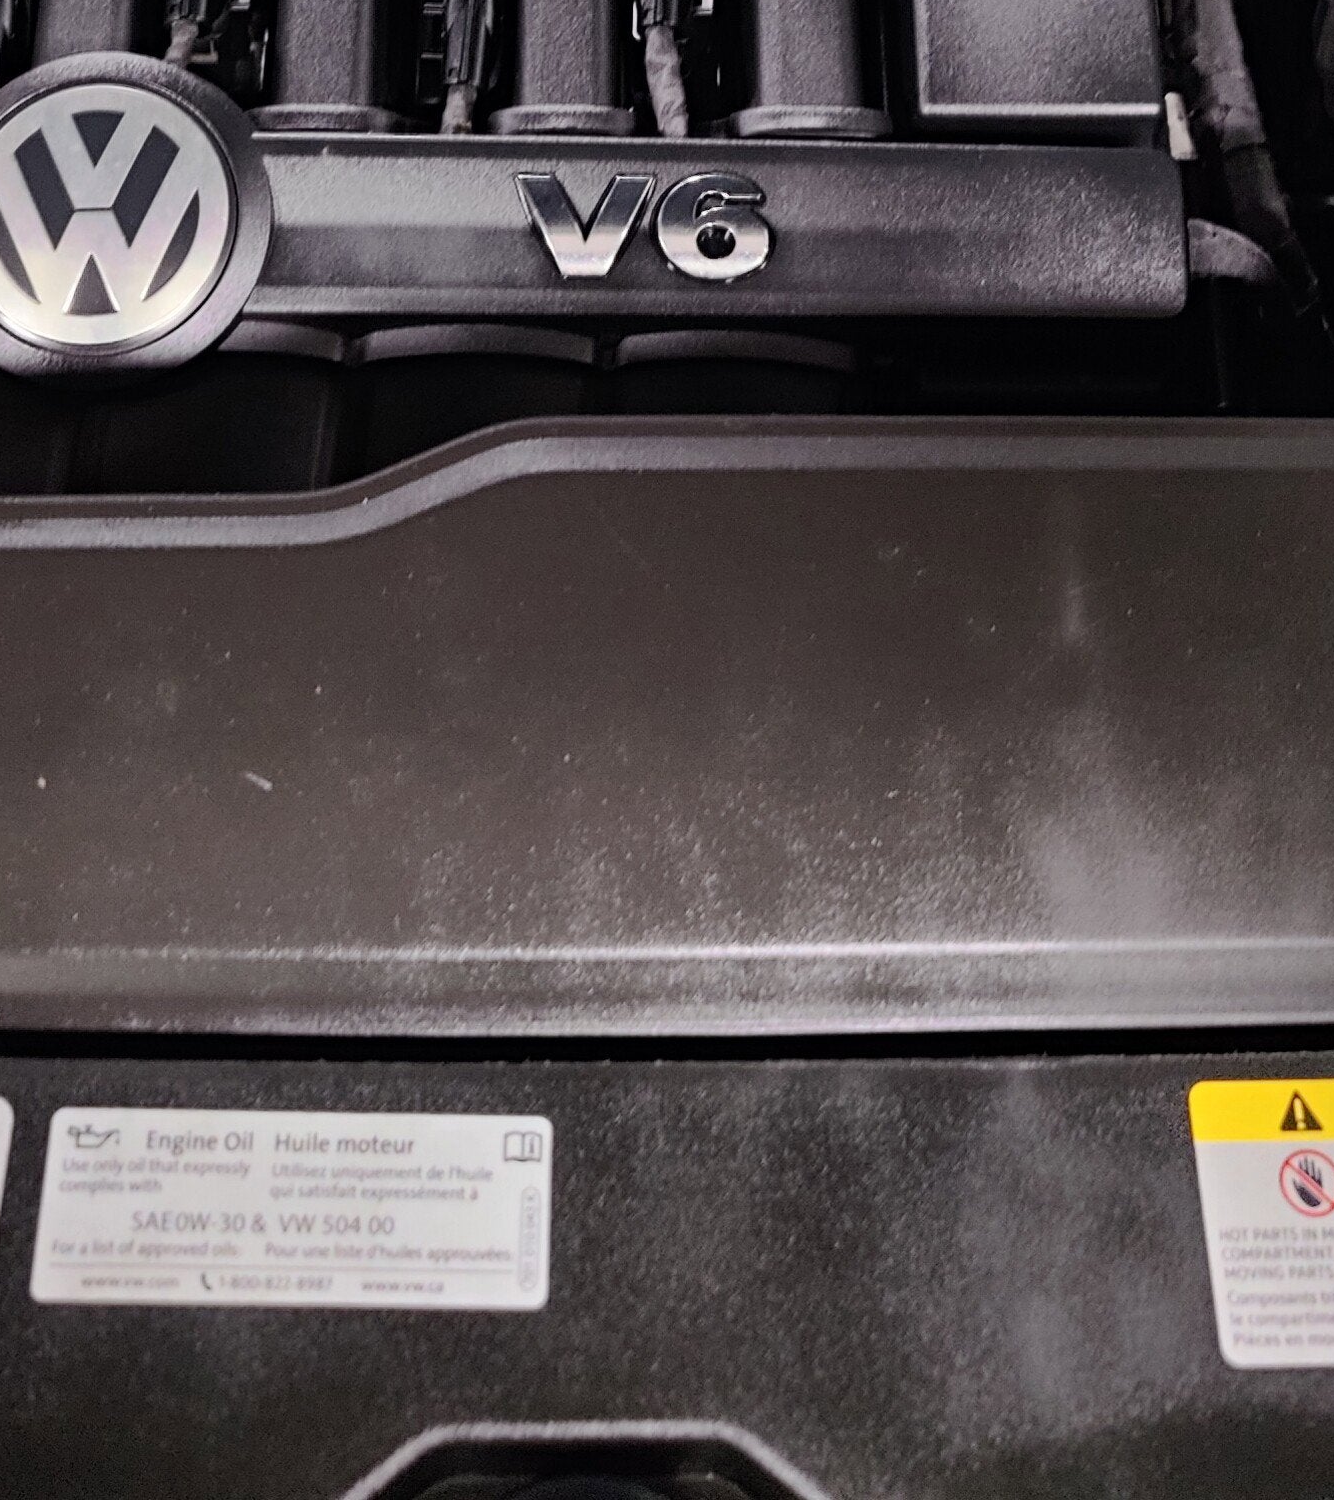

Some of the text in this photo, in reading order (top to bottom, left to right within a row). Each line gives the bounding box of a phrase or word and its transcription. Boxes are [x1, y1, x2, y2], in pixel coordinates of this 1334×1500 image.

[515, 171, 774, 280] V6
[146, 1128, 254, 1157] Engine Oil
[274, 1131, 414, 1154] Huile moteur
[131, 1210, 170, 1232] SAE
[250, 1212, 266, 1233] &
[279, 1212, 316, 1234] VW
[322, 1214, 361, 1235] 504
[367, 1214, 395, 1235] 00
